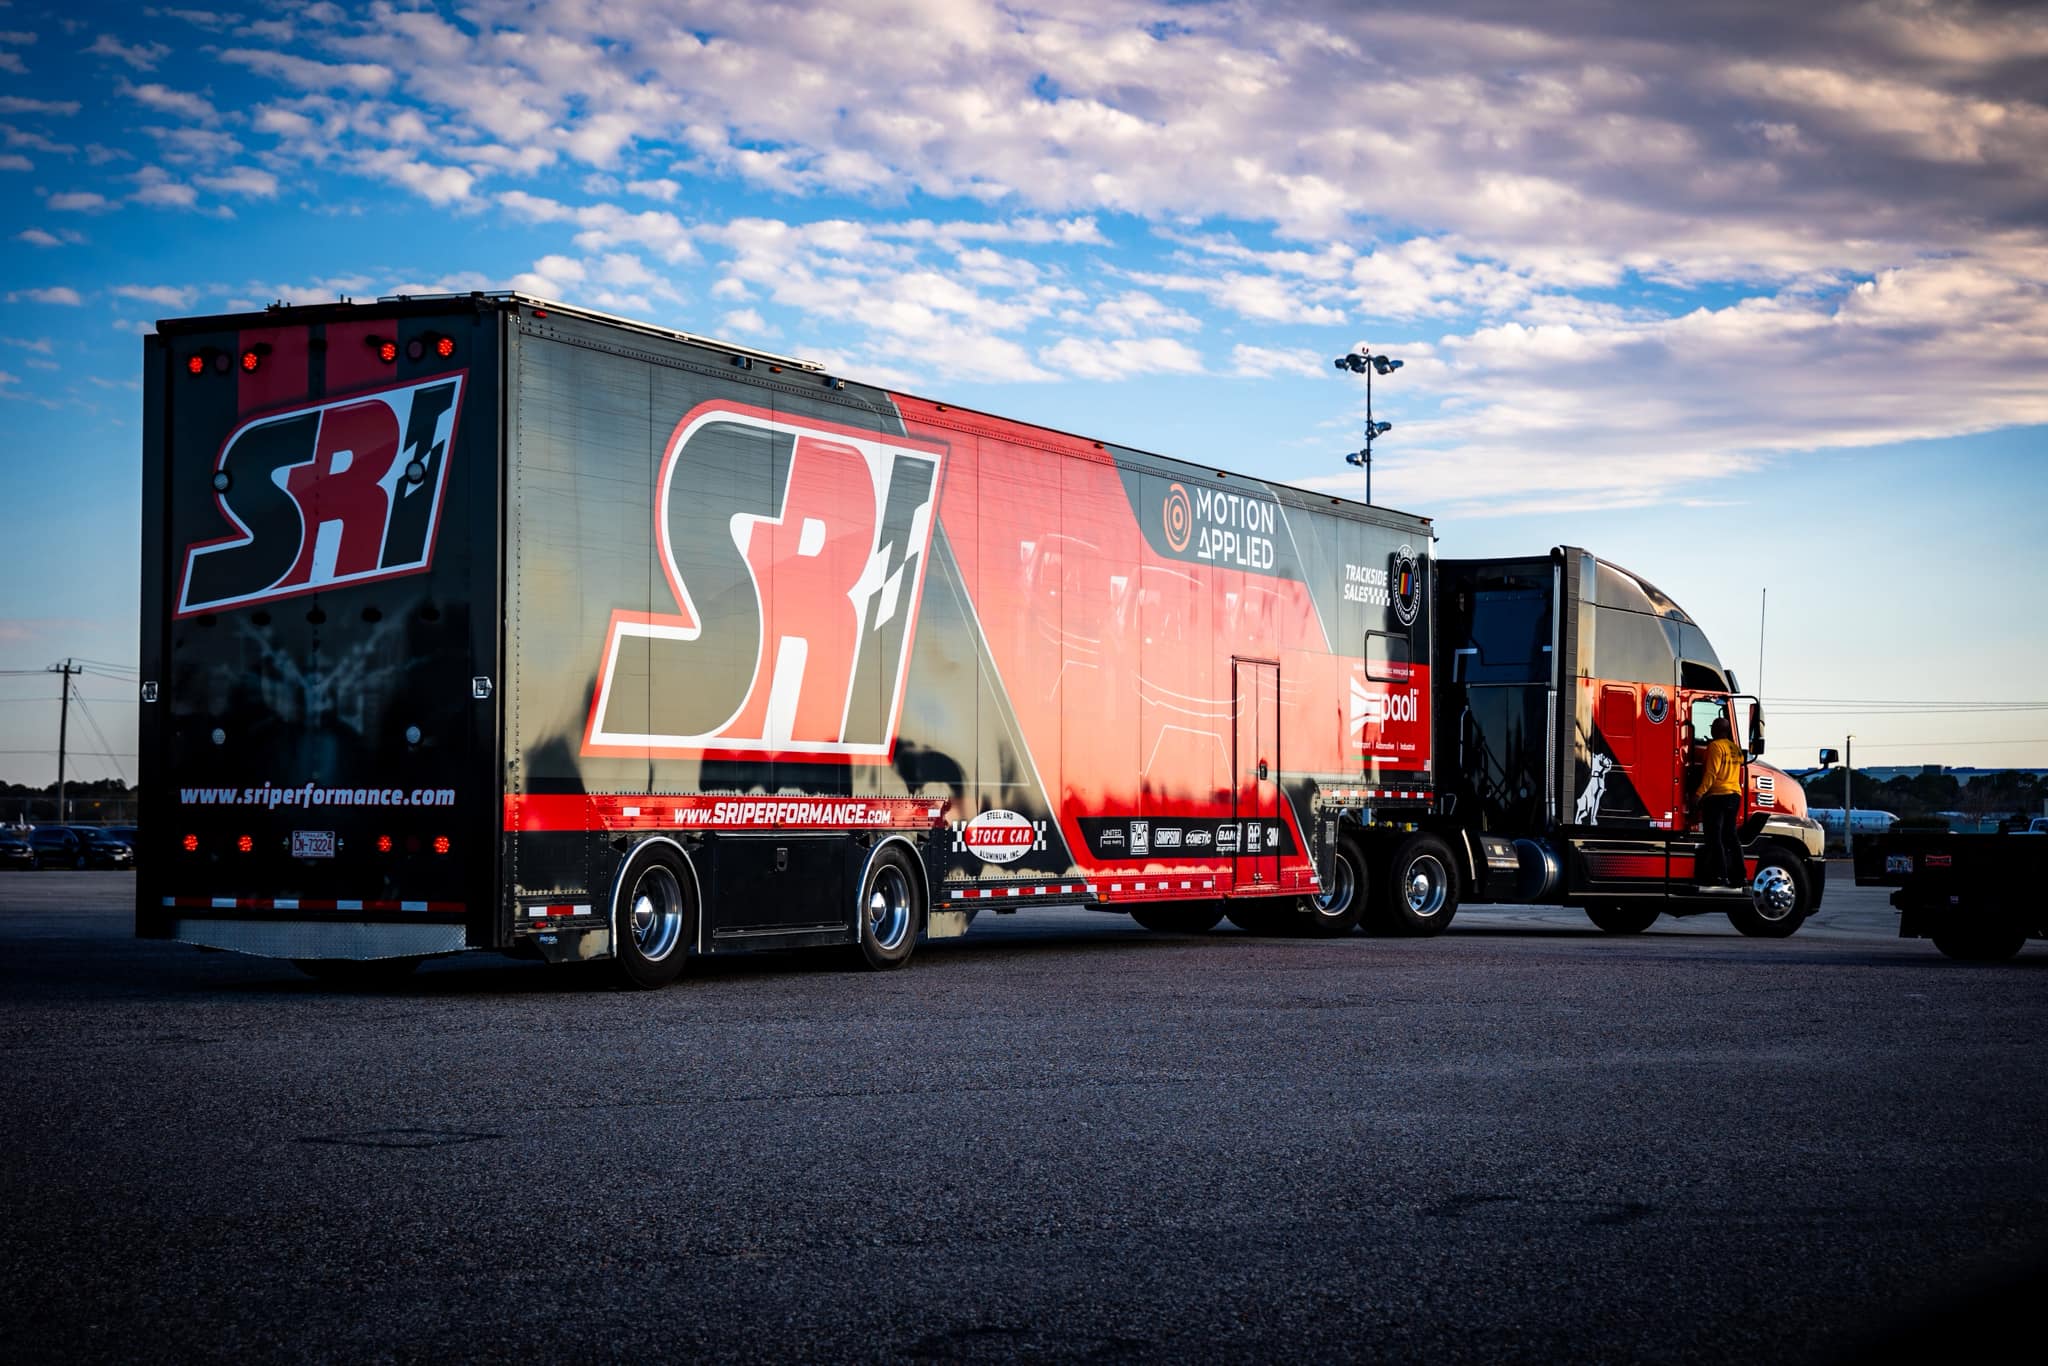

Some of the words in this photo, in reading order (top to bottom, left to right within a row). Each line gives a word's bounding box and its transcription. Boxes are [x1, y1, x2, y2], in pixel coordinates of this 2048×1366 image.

[175, 371, 466, 617] SRI
[1196, 487, 1274, 535] MOTION
[1197, 526, 1274, 570] APPLIED
[583, 403, 947, 762] SRI
[1345, 564, 1388, 587] TRACKSIDE
[1343, 583, 1368, 603] SALES
[1380, 688, 1418, 734] paoli
[180, 781, 455, 809] www.sriperformance.com
[986, 812, 1002, 821] STEEL
[1003, 812, 1014, 821] AND
[970, 829, 1005, 844] STOCK
[1009, 829, 1030, 843] CAR
[1156, 830, 1181, 845] SIMPSON
[1185, 831, 1212, 846] COMETIC
[1267, 828, 1279, 847] 3M
